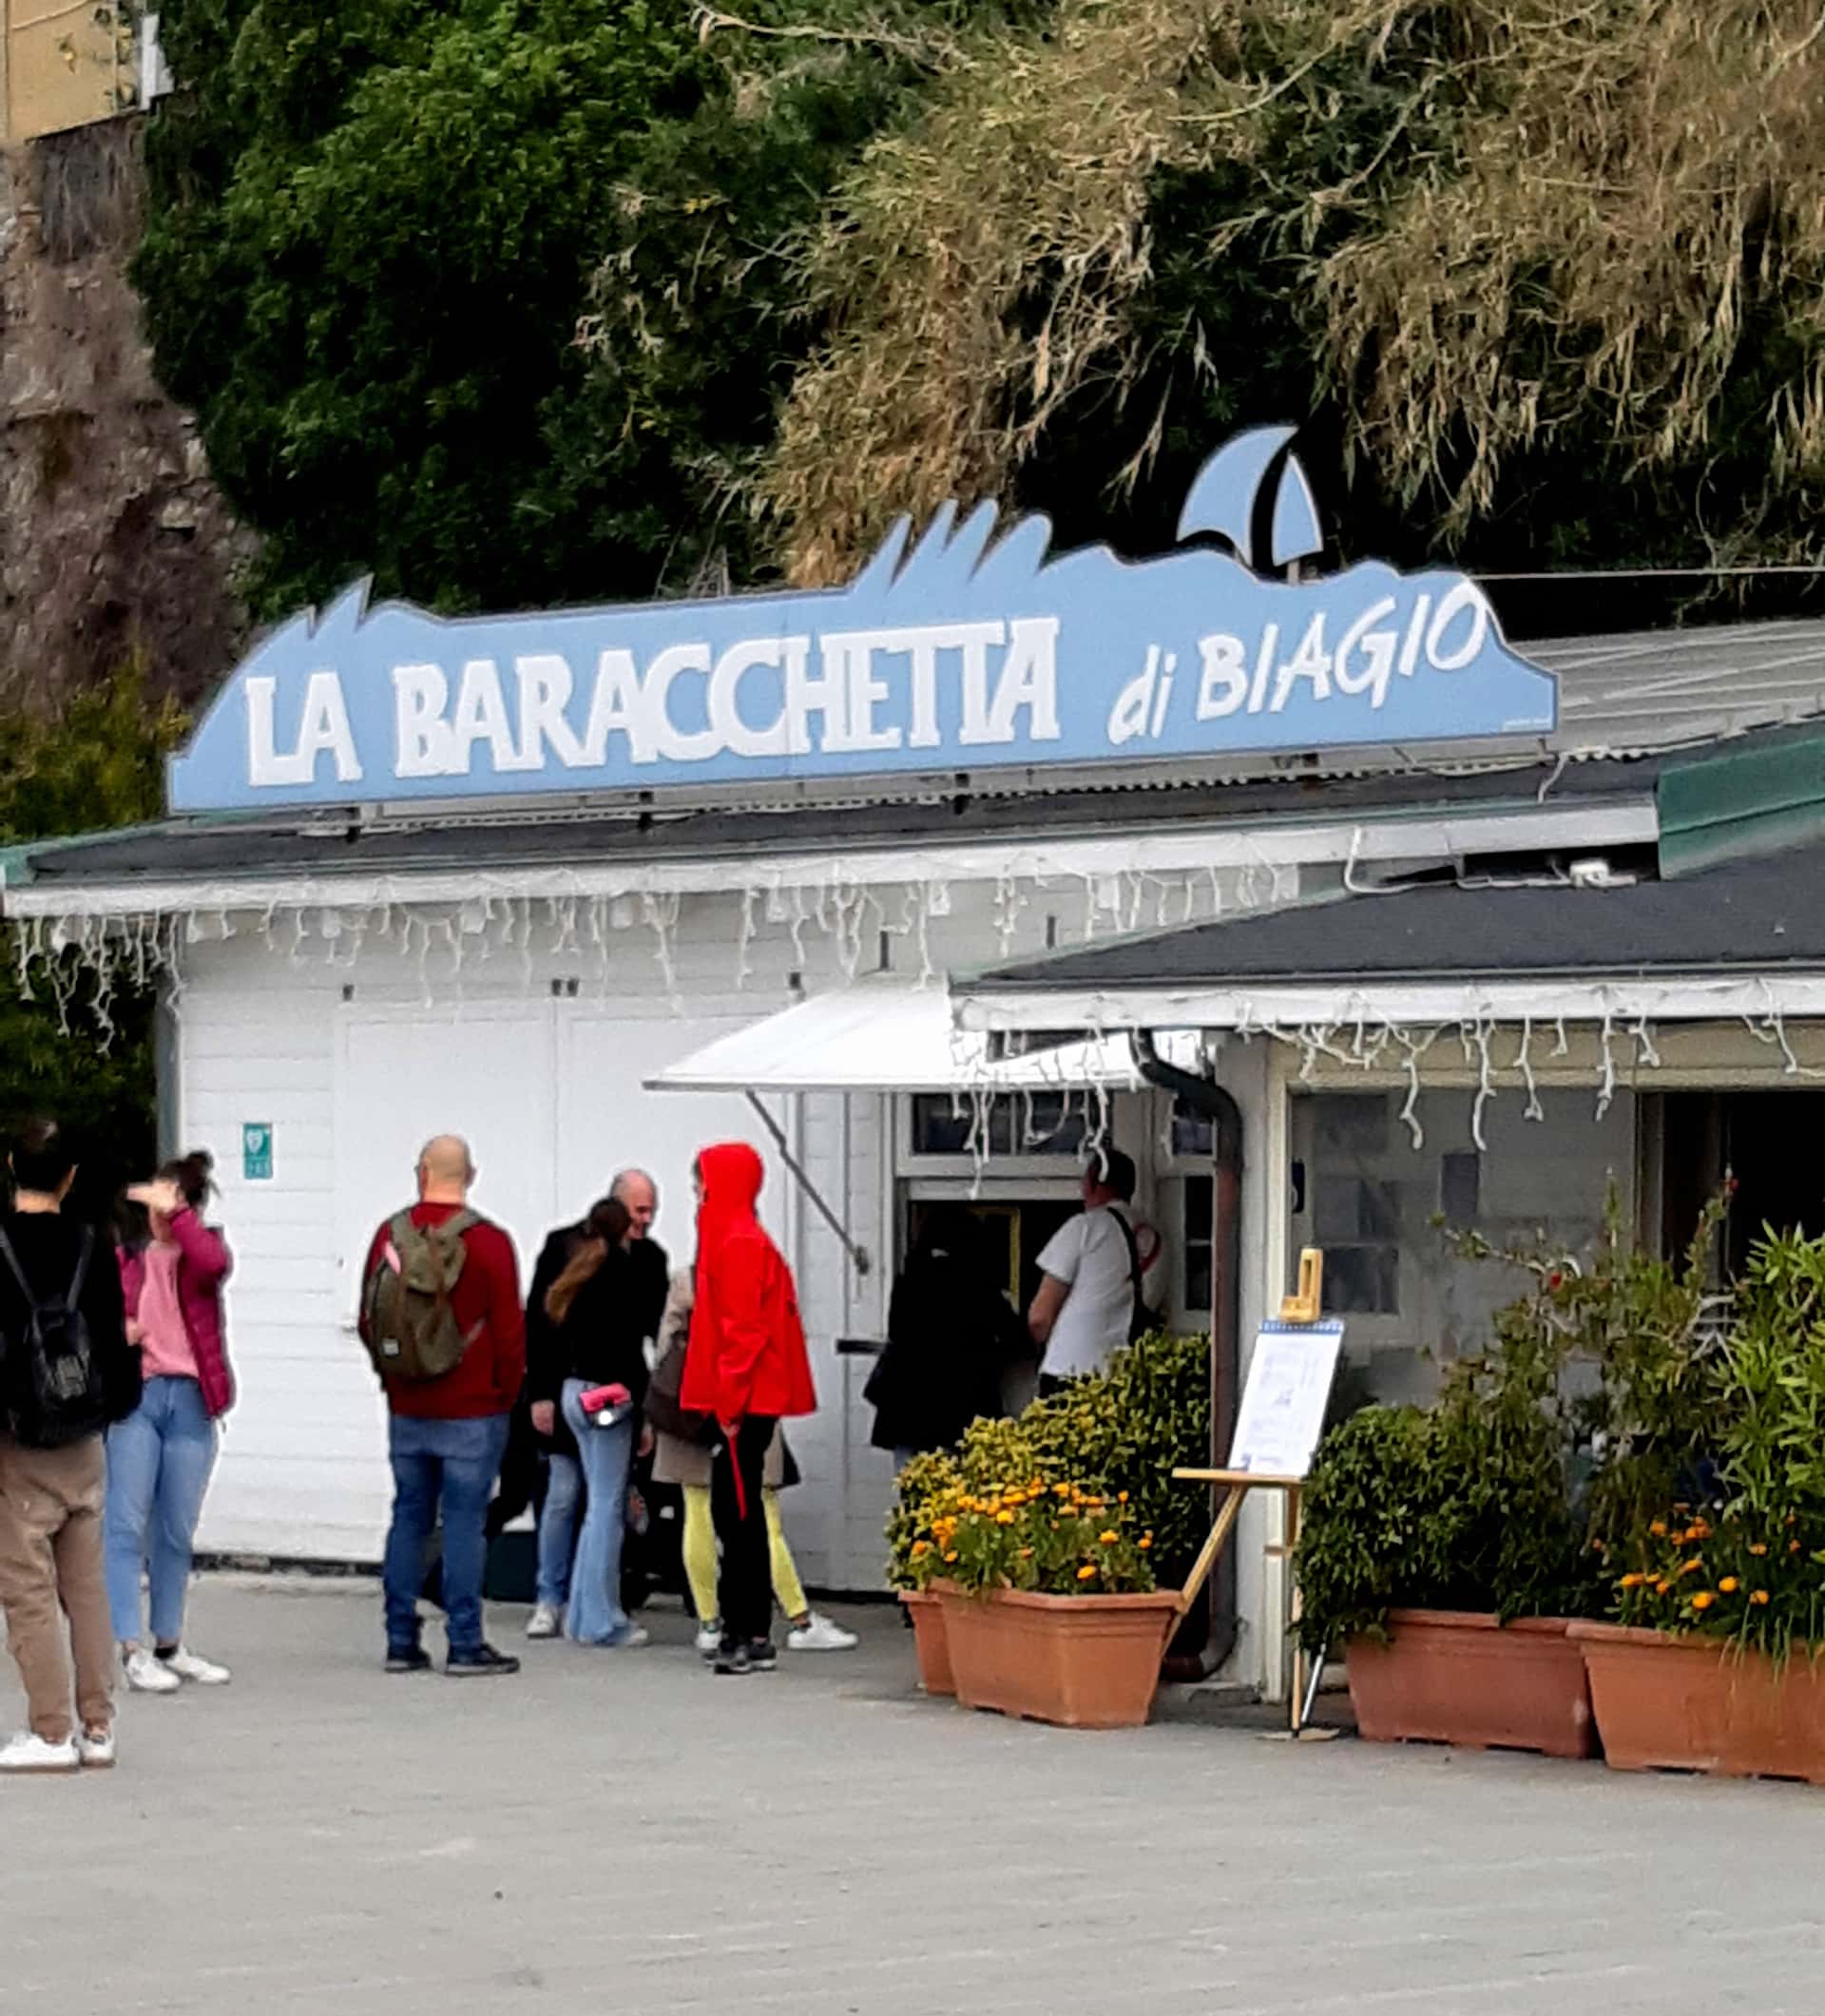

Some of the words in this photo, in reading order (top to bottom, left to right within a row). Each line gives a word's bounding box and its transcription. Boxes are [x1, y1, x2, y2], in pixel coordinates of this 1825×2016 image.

[245, 671, 362, 787] LA
[392, 616, 1061, 779] BARACCHETTA
[1107, 643, 1177, 745] di
[1197, 582, 1487, 722] BIAGIO
